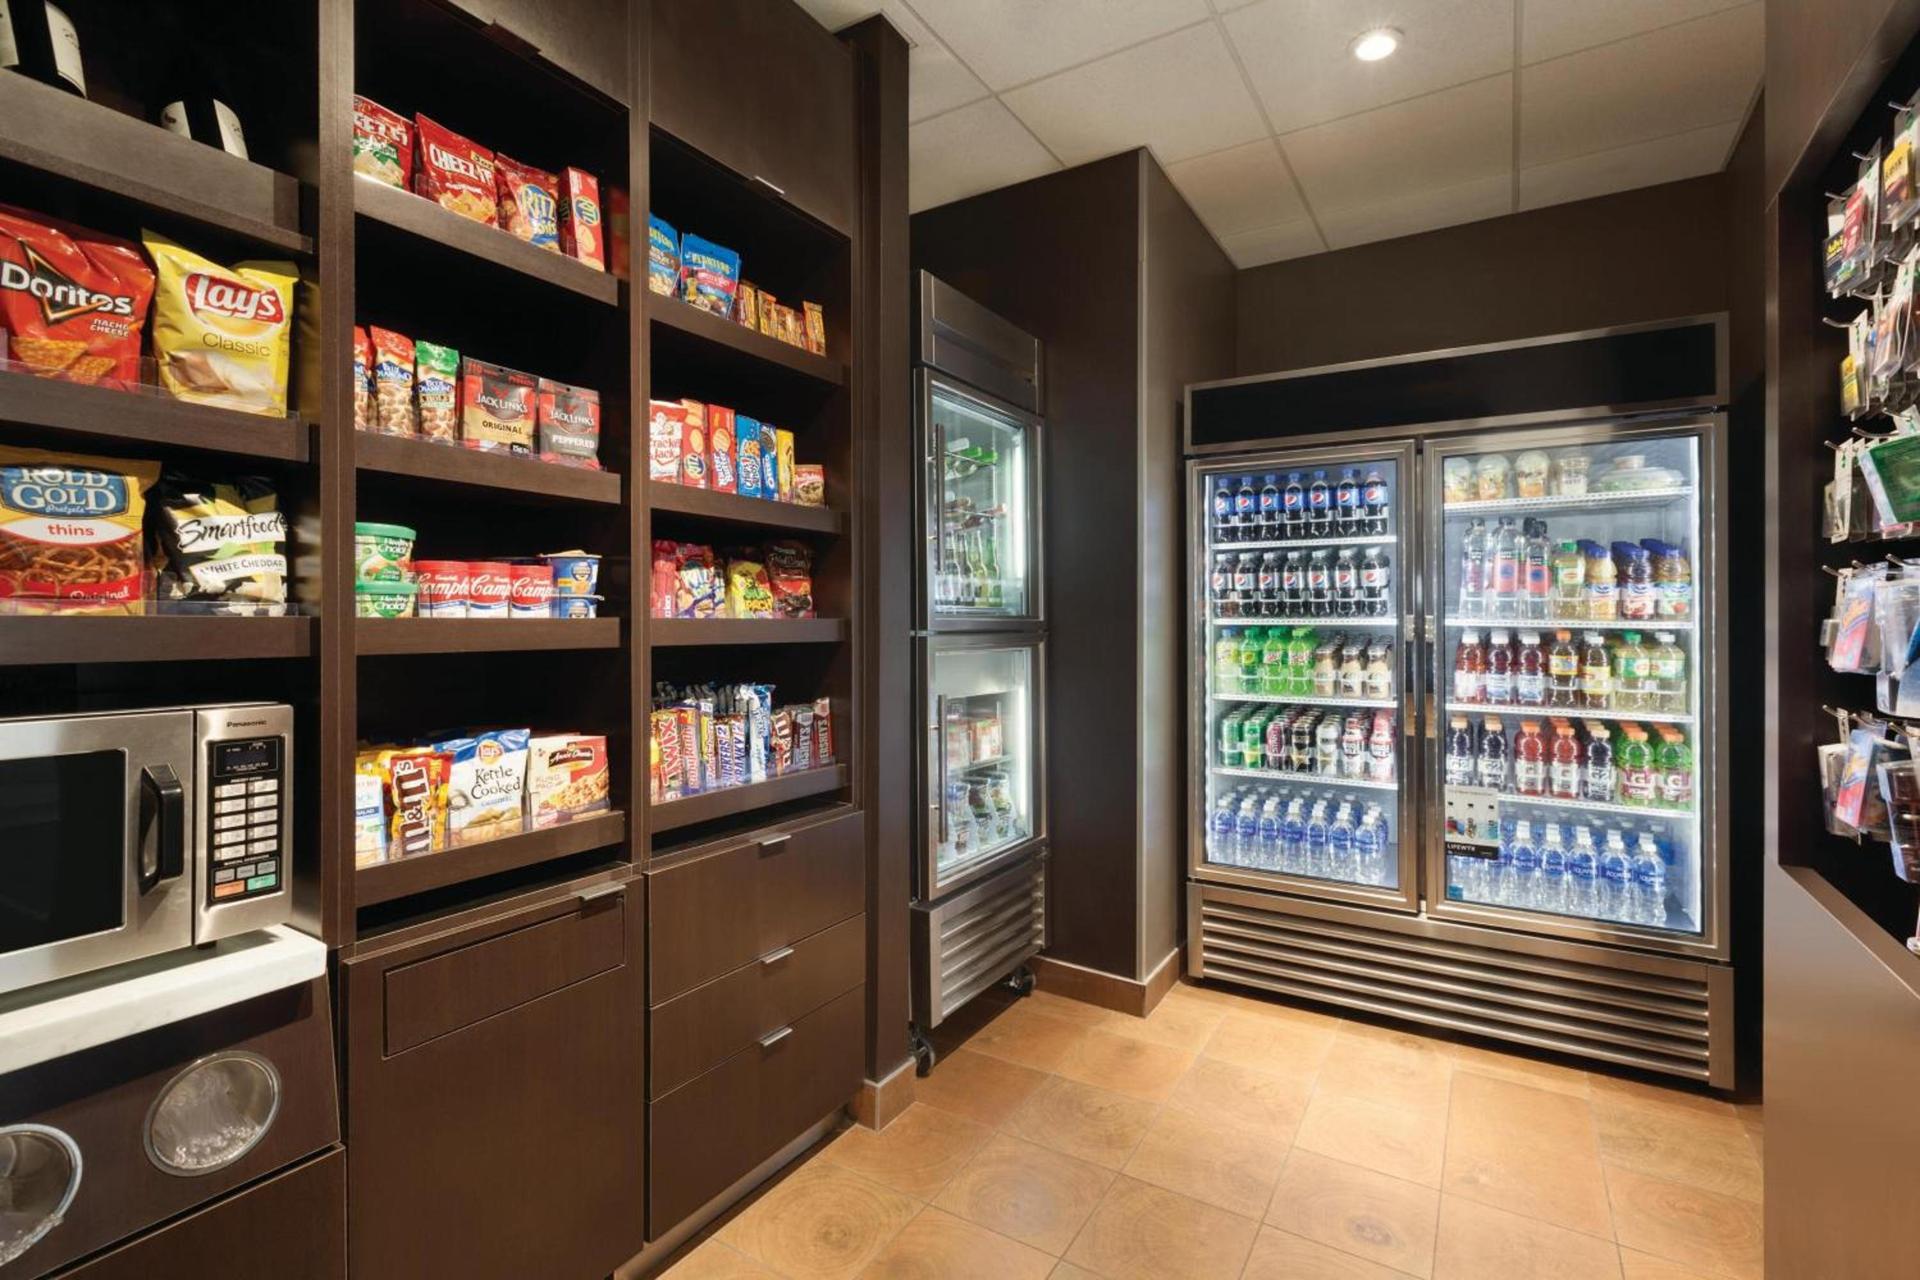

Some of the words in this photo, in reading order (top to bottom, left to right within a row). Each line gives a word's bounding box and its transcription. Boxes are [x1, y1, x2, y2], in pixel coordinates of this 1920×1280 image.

[1, 260, 133, 315] Doritos
[194, 274, 277, 320] Lay's
[202, 332, 271, 357] Classic
[476, 393, 499, 409] JACK
[482, 420, 522, 434] ORIGINAL
[552, 434, 595, 449] PEPPERED
[12, 484, 117, 511] GOLD
[47, 524, 95, 536] thins
[177, 512, 282, 548] Smartfood
[226, 719, 267, 728] Panasonic
[657, 717, 682, 786] TWIX
[475, 765, 513, 785] Kettle
[471, 776, 521, 800] Cooked
